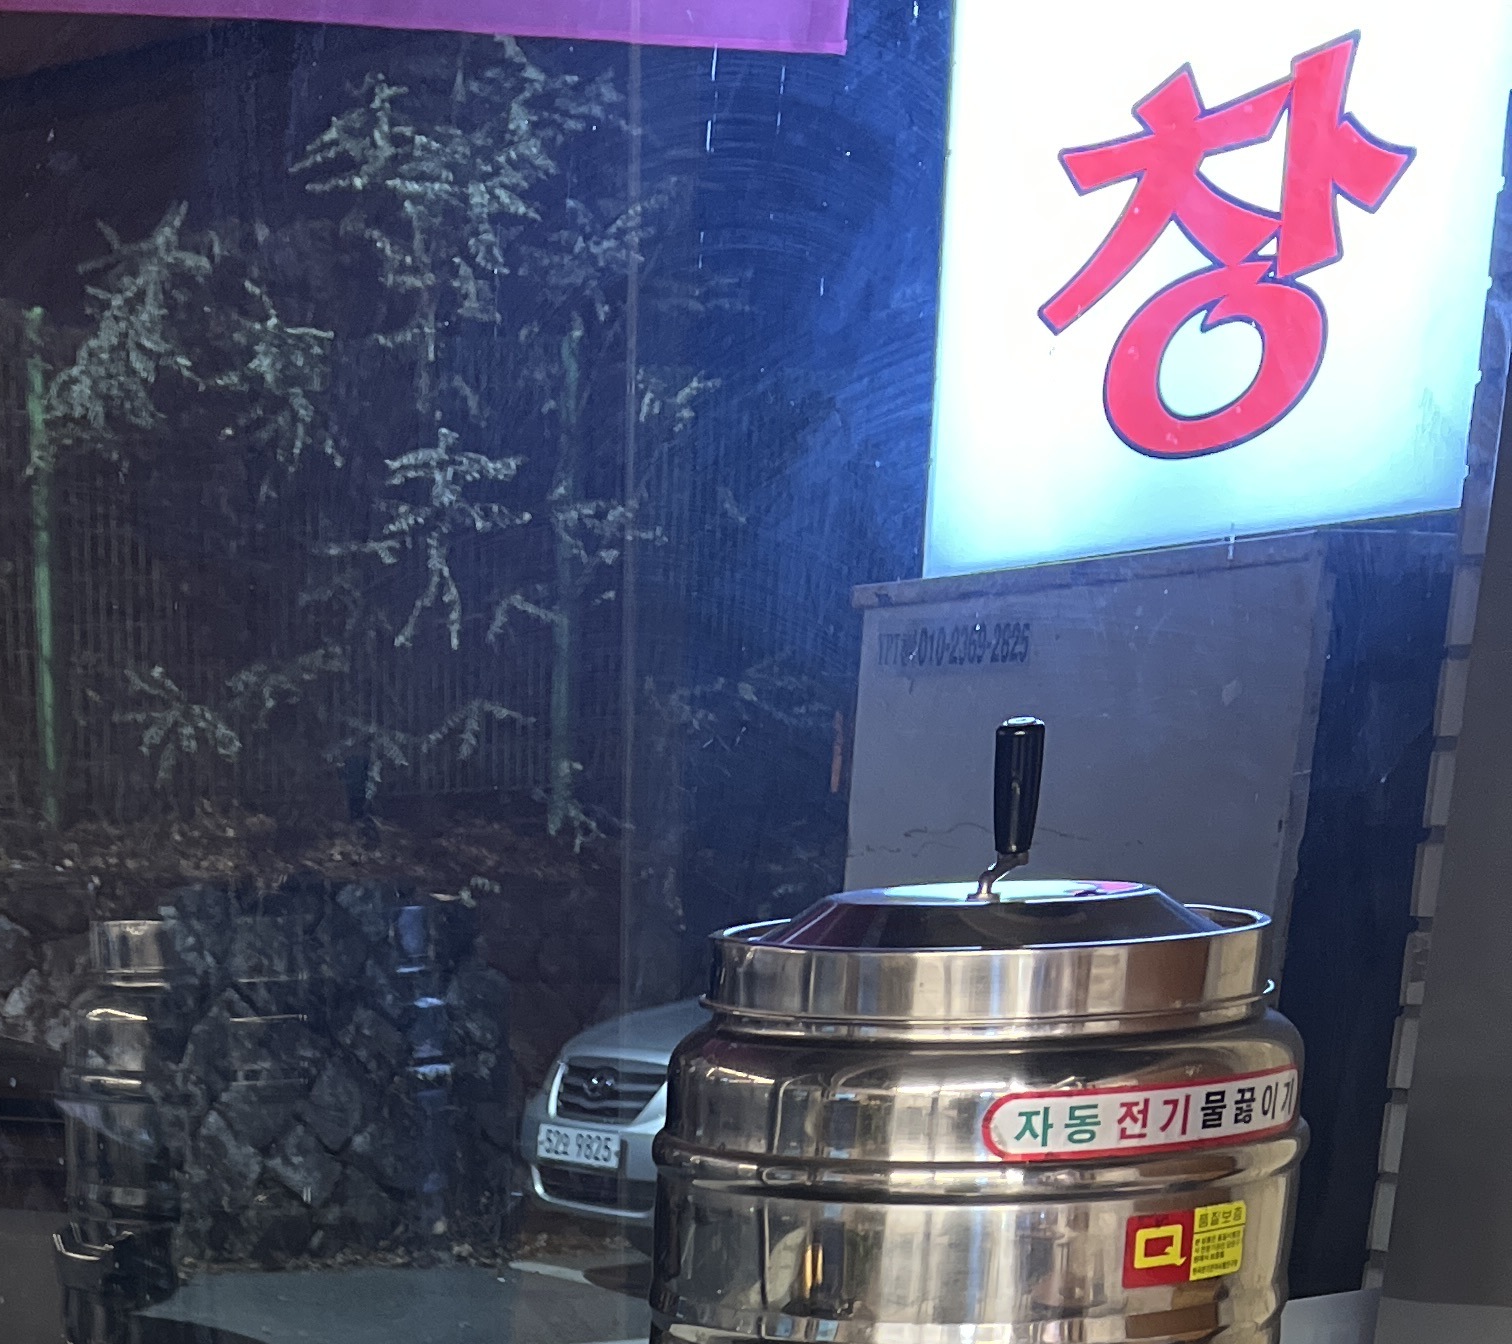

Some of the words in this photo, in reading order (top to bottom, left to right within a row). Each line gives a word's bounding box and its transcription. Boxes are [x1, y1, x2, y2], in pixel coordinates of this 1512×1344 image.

[1037, 28, 1417, 461] 창
[1014, 1103, 1102, 1147] 자동
[1116, 1094, 1192, 1141] 전기
[1200, 1078, 1295, 1130] 물끓이기
